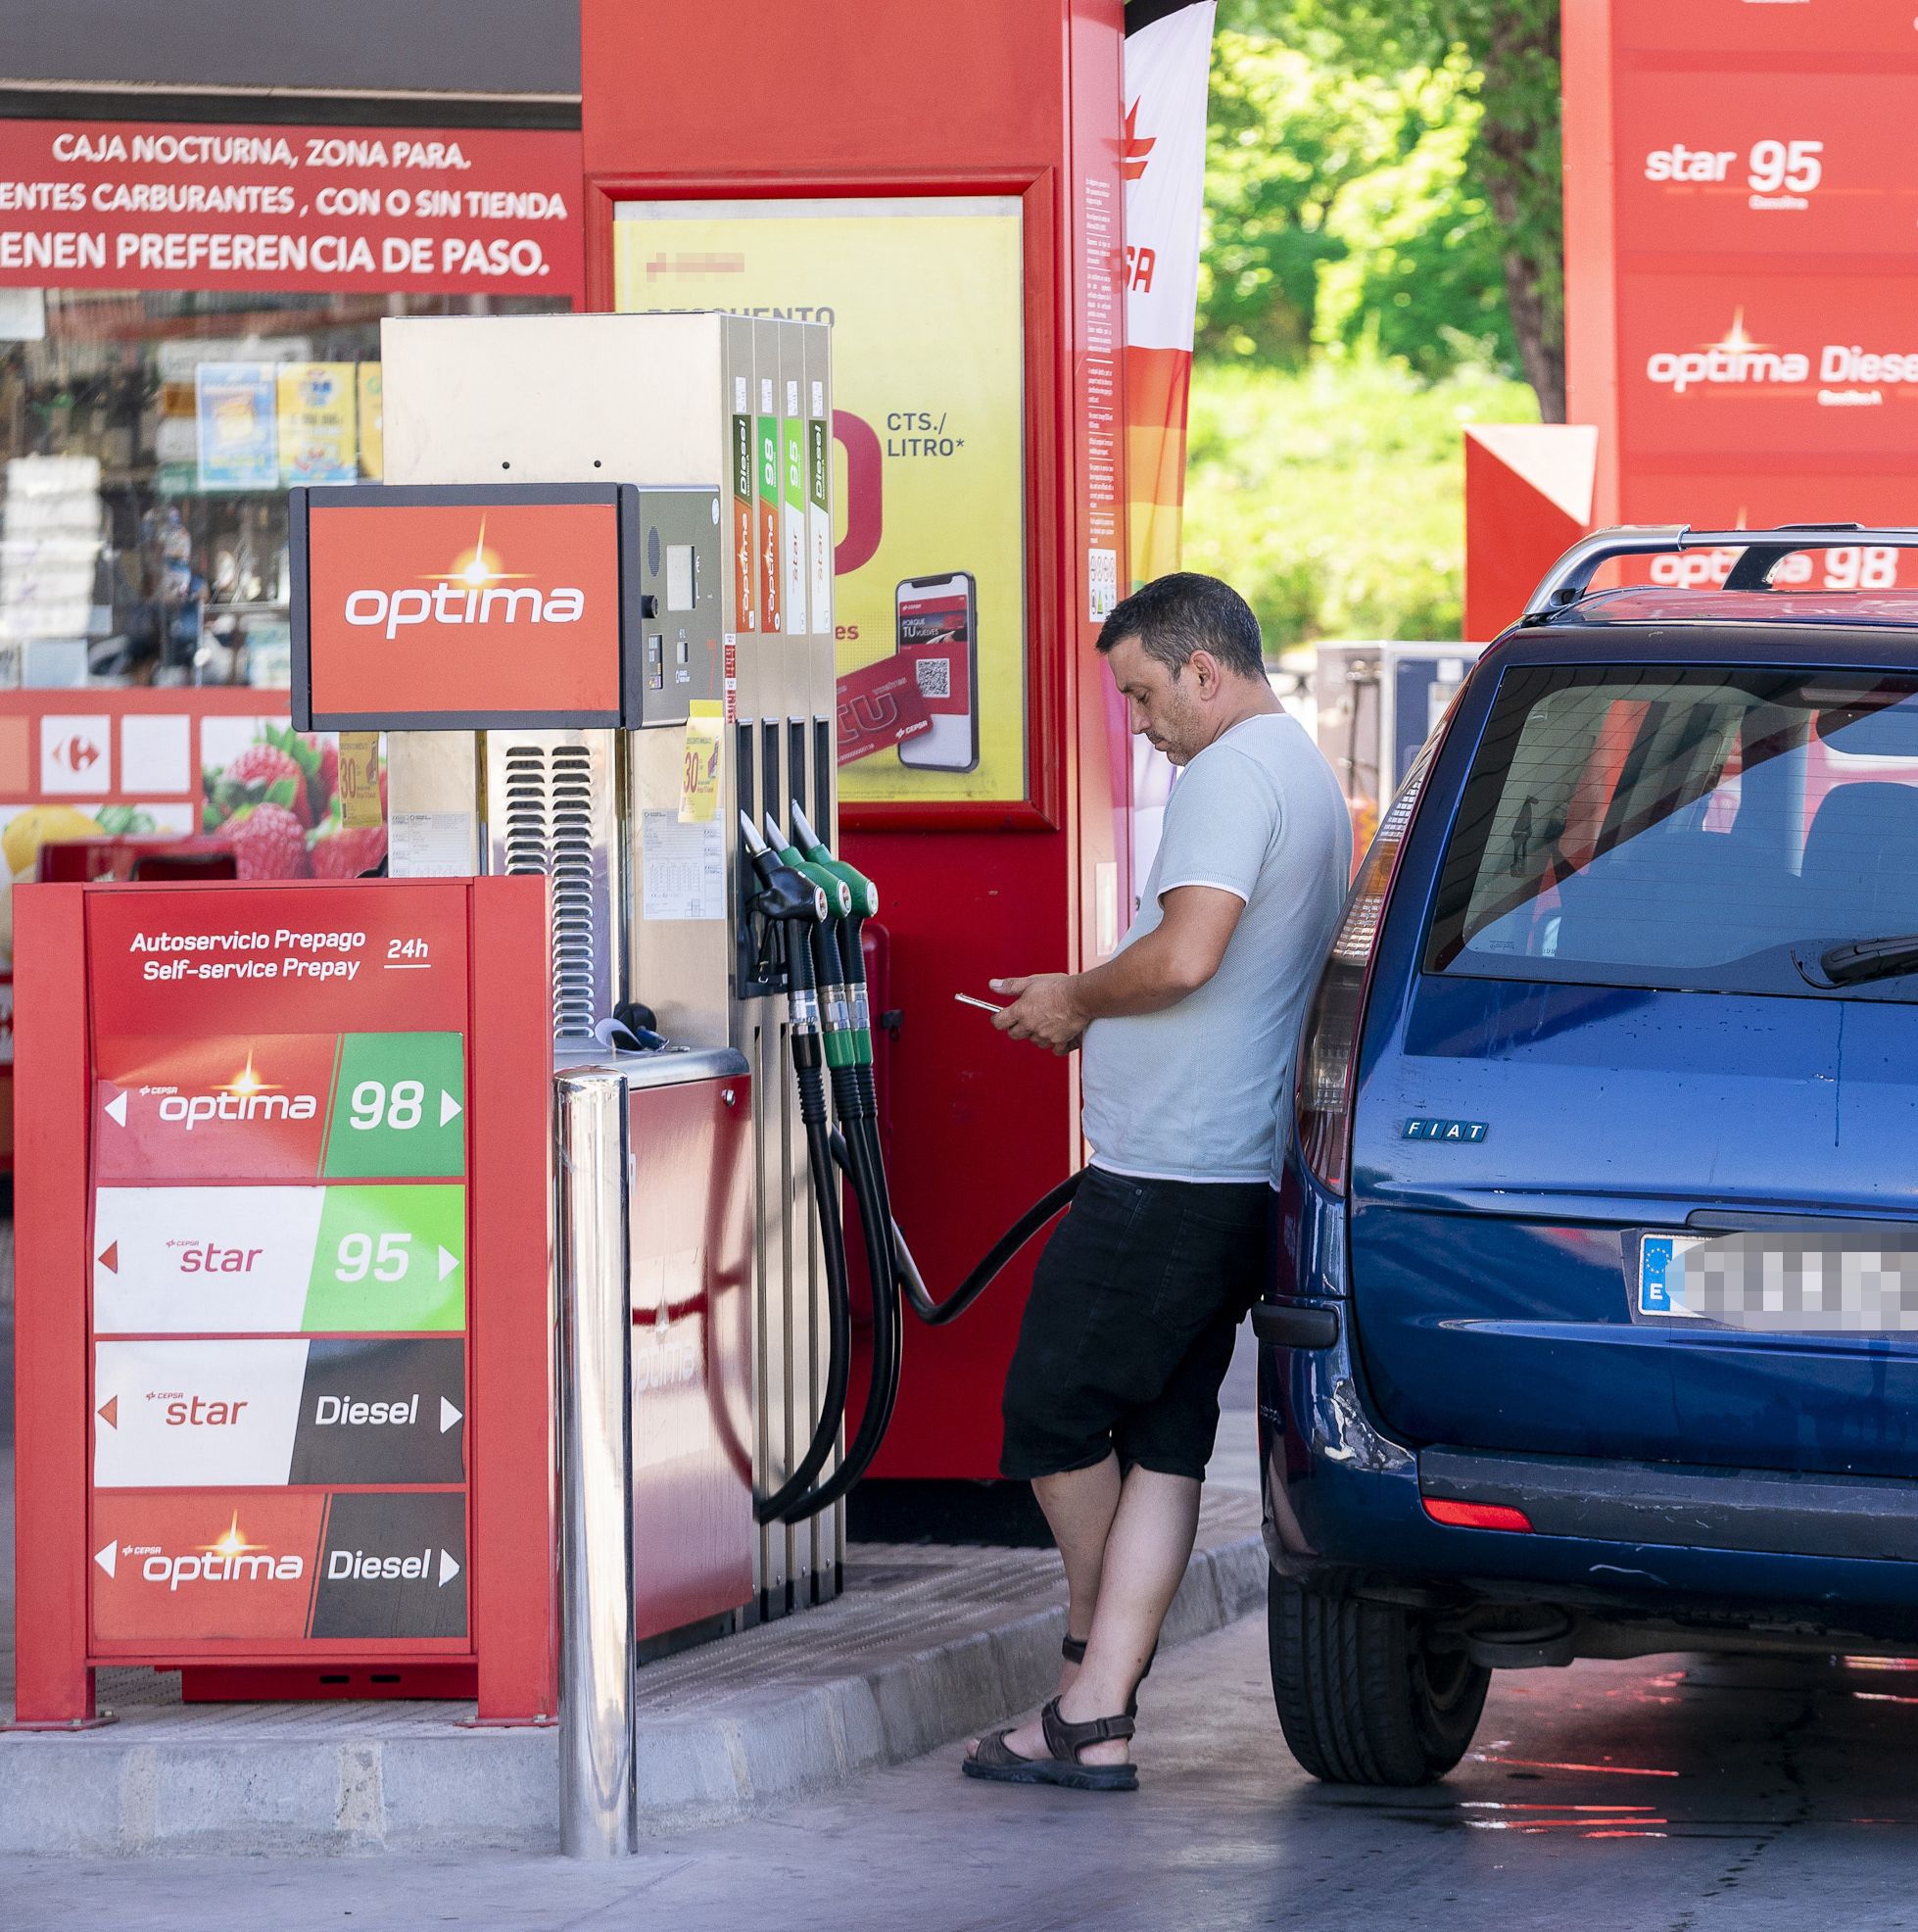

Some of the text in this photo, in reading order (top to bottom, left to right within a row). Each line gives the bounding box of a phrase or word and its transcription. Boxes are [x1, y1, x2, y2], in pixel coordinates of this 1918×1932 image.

[52, 133, 472, 169] CAJA NOCTURNA, ZONA PARA.
[1645, 140, 1824, 192] star 95
[0, 182, 87, 212] ENTES
[92, 182, 295, 216] CARBURANTES
[315, 187, 382, 217] CON
[385, 188, 410, 217] O
[415, 189, 461, 217] SIN
[464, 192, 568, 220] TIENDA
[0, 231, 551, 276] ENEN PREFERENCIA DE PASO.
[1647, 349, 1810, 393] optima
[887, 412, 947, 435] CTS./
[739, 419, 748, 496] Diesel
[790, 439, 798, 488] 95
[814, 424, 823, 500] Diesel
[764, 437, 776, 611] optima 98
[742, 512, 750, 611] optima
[1650, 547, 1899, 590] opta 98
[345, 582, 585, 640] optima
[903, 625, 917, 638] TU
[340, 757, 357, 798] 30
[684, 751, 699, 794] 30
[130, 929, 429, 959] Autoservicio Prepago 24h
[143, 957, 360, 982] Self-service Prepay
[151, 1086, 178, 1095] CEPSA
[159, 1080, 425, 1131] optima 98
[1407, 1121, 1483, 1140] FIAT
[180, 1232, 412, 1282] star 95
[1650, 1282, 1664, 1300] E
[166, 1393, 419, 1426] star Diesel
[133, 1545, 163, 1555] CEPSA
[143, 1548, 432, 1591] optima Diesel
